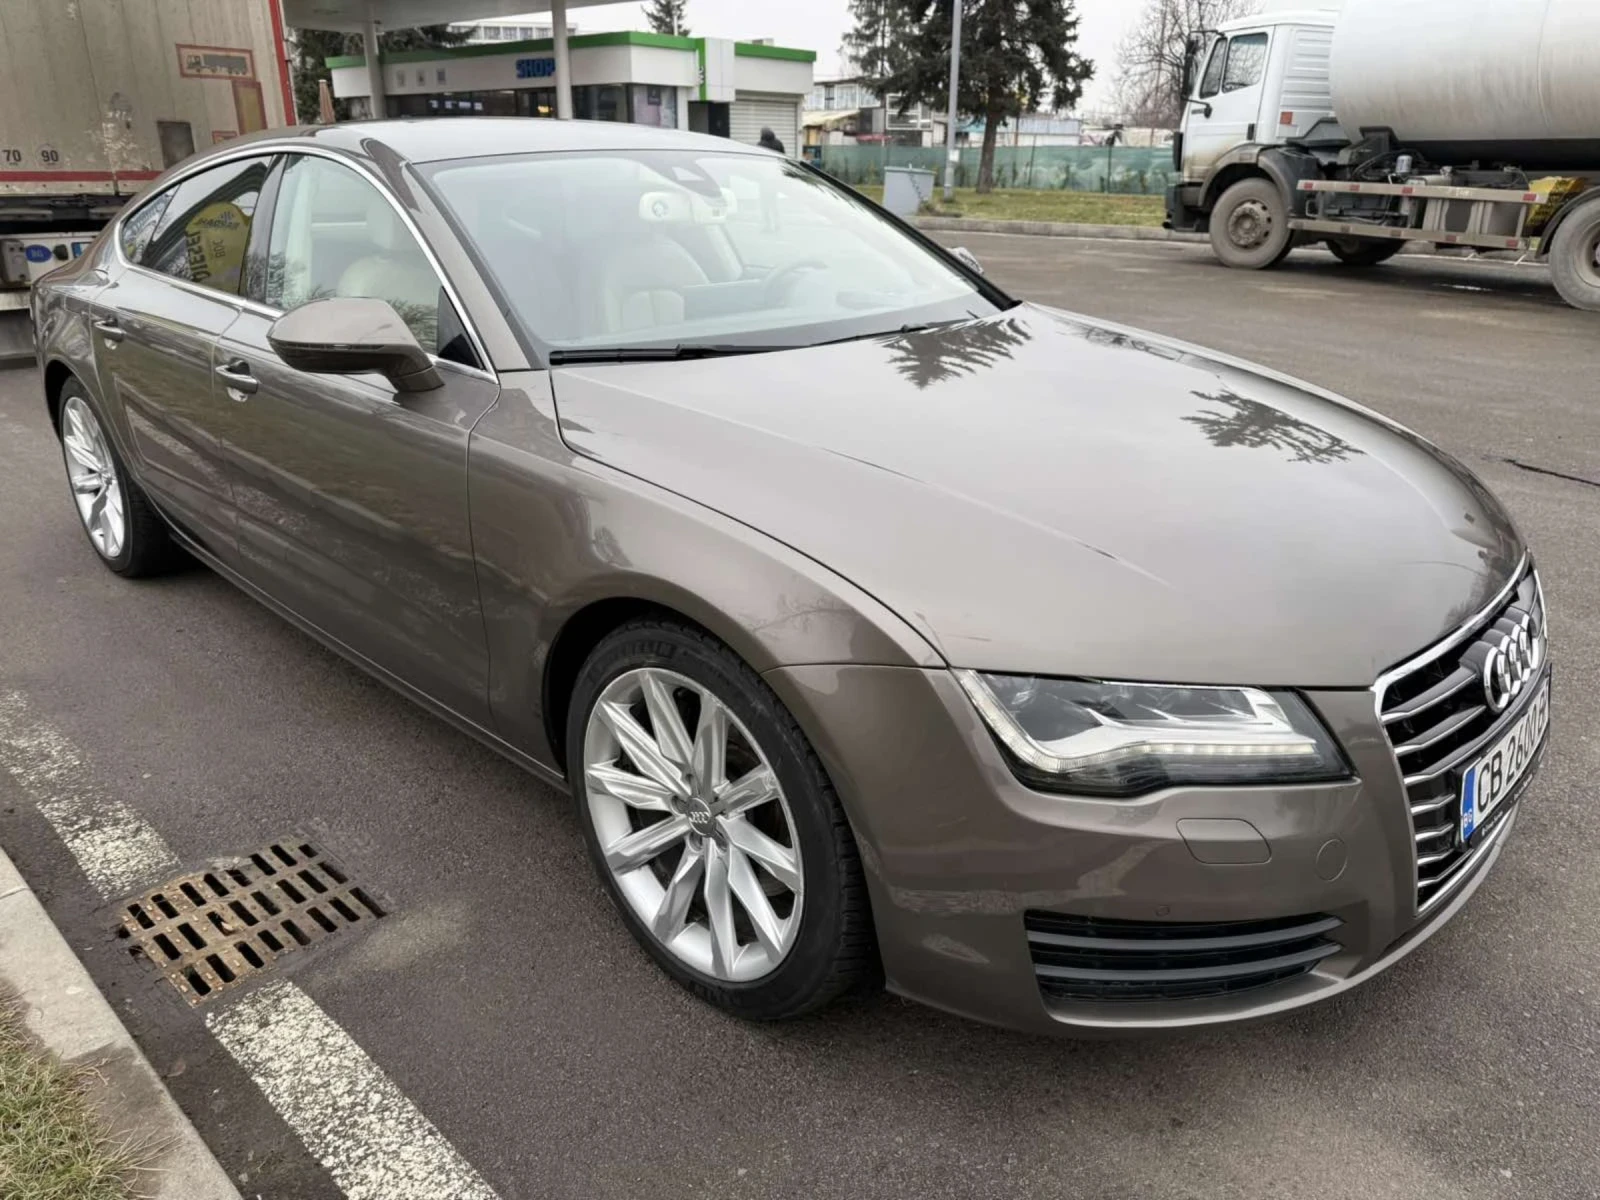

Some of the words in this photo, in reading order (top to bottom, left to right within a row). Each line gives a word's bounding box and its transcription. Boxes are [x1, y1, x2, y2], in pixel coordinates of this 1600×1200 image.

[516, 58, 556, 79] SHOP
[2, 149, 22, 162] 70
[41, 150, 59, 162] 90
[1477, 750, 1503, 813] CB
[1505, 703, 1537, 785] 2600
